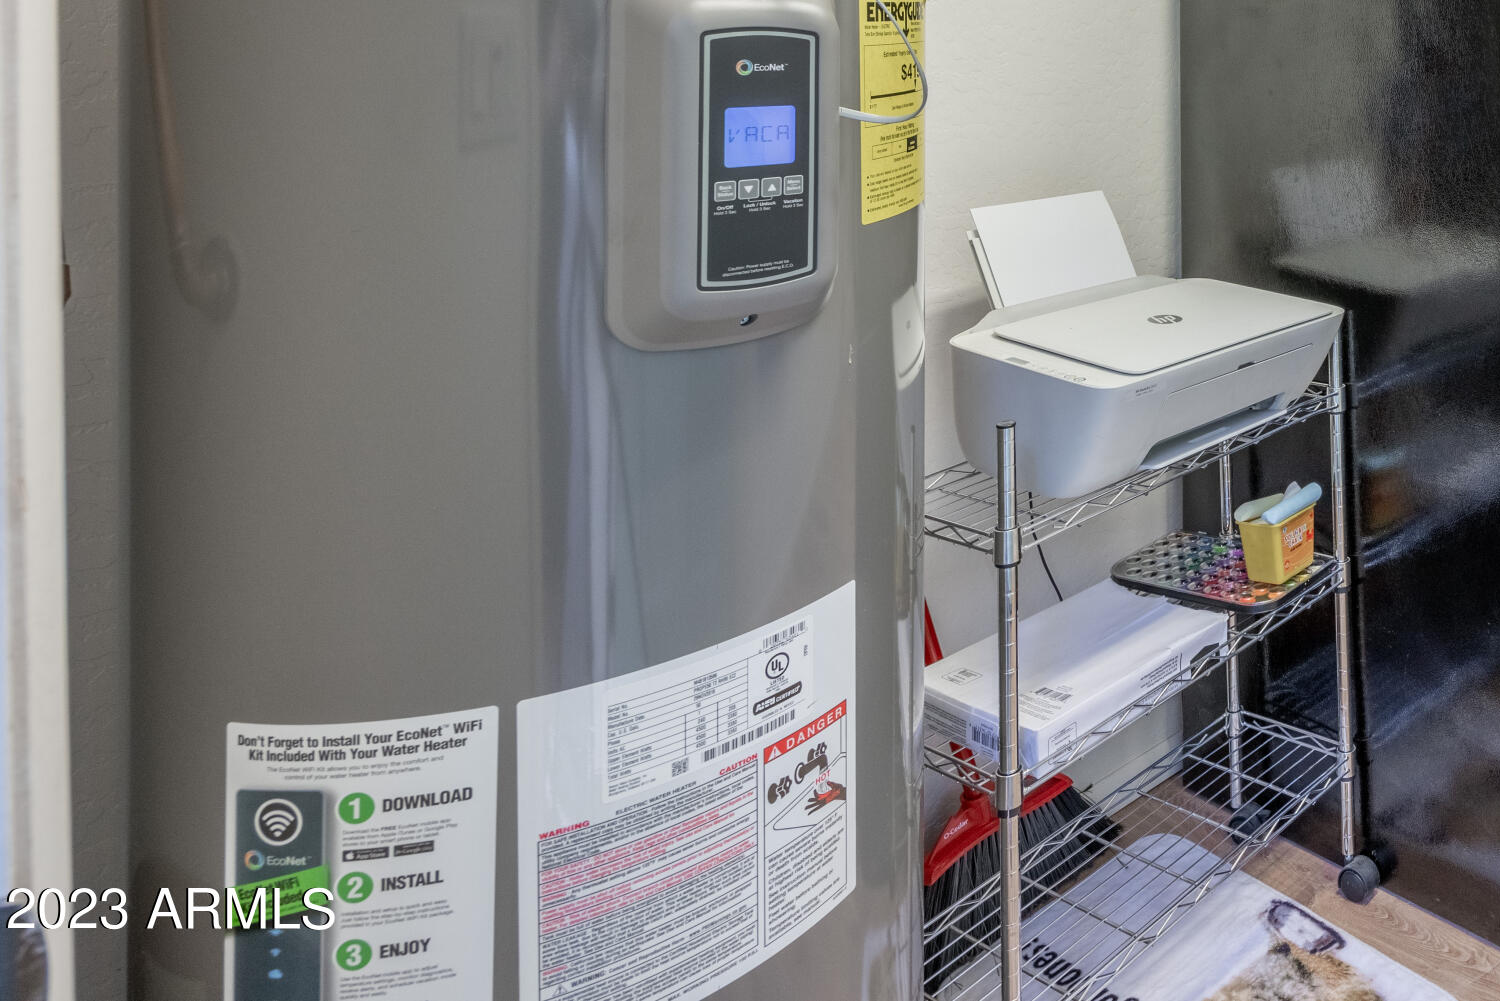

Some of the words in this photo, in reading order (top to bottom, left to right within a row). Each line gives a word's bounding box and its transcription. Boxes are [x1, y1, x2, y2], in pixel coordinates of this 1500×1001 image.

[728, 124, 790, 144] VACA
[771, 659, 784, 671] UL
[237, 734, 265, 747] Don't
[267, 736, 304, 751] Forget
[307, 737, 319, 748] to
[322, 734, 360, 747] Install
[364, 732, 393, 745] Your
[453, 719, 483, 734] WiFi
[786, 706, 843, 750] DANGER
[249, 749, 264, 761] Kit
[266, 750, 315, 762] Included
[319, 748, 346, 761] With
[350, 748, 378, 760] Your
[382, 744, 420, 757] Water
[423, 737, 468, 752] Heater
[719, 752, 758, 776] CAUTION
[815, 769, 831, 785] HOT
[348, 797, 361, 820] 1
[382, 787, 473, 813] DOWNLOAD
[615, 799, 648, 816] ELECTRIC
[650, 791, 671, 802] WATER
[673, 780, 697, 794] HEATER
[538, 819, 591, 840] WARNING
[347, 876, 364, 899] 2
[381, 870, 444, 892] INSTALL
[345, 943, 362, 967] 3
[379, 937, 431, 959] ENJOY
